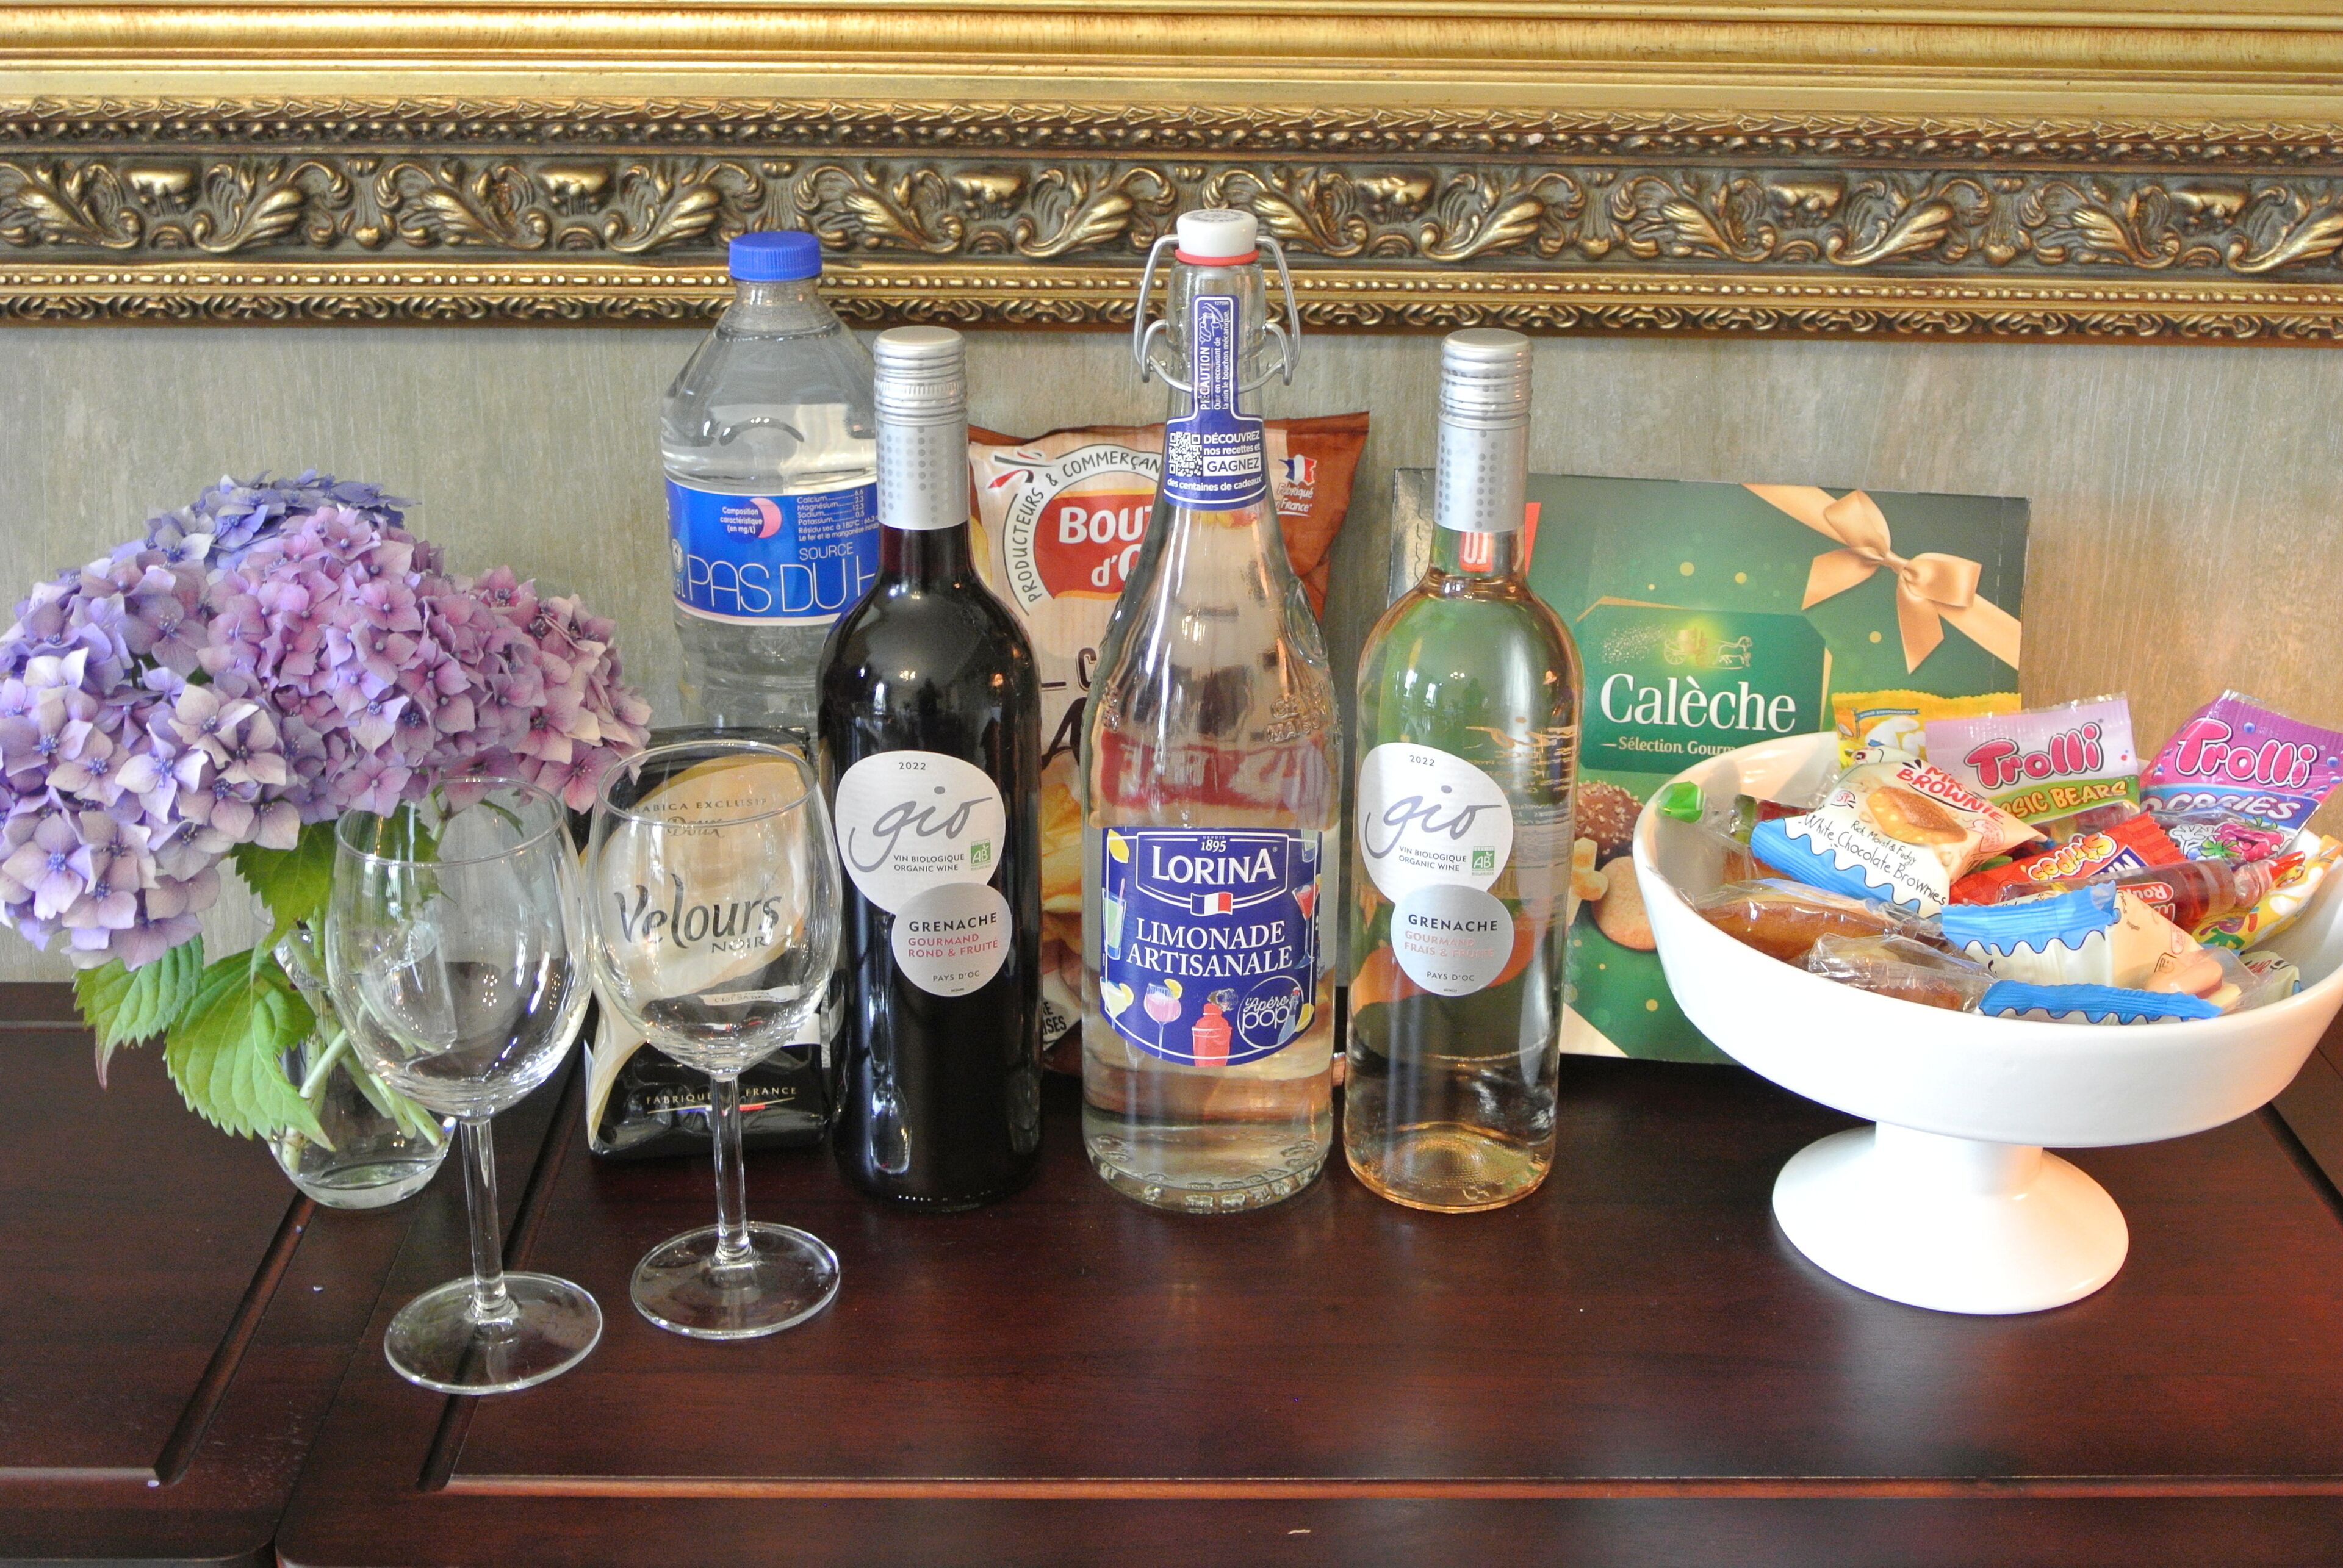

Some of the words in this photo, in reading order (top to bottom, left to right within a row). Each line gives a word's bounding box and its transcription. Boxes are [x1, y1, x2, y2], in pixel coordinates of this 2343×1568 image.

[1214, 337, 1222, 347] de
[1198, 347, 1211, 410] PRÉCAUTION
[1214, 384, 1222, 394] en
[1222, 401, 1229, 410] la
[1203, 430, 1261, 444] DÉCOUVREZ
[1222, 444, 1253, 455] recettes
[1254, 442, 1261, 451] et
[1207, 457, 1259, 472] GAGNEZ
[1167, 478, 1179, 487] des
[1179, 481, 1219, 491] centaines
[1220, 482, 1232, 491] de
[797, 495, 827, 504] Calcium
[797, 502, 838, 512] Magnésium
[722, 506, 758, 516] Composition
[719, 516, 763, 526] caractéristique
[727, 525, 737, 533] (en
[798, 517, 833, 525] Potassium
[1012, 487, 1045, 603] PRODUCTEURS
[1046, 473, 1059, 487] &
[799, 541, 854, 561] SOURCE
[687, 555, 771, 612] PAS
[780, 559, 846, 612] DU
[1600, 673, 1796, 733] Calèche
[1618, 736, 1685, 755] Sélection
[2175, 717, 2317, 789] Trolli
[1409, 754, 1435, 767] 2022
[1964, 722, 2104, 789] Trolli
[899, 761, 926, 771] 2022
[1896, 768, 2004, 824] BROWNIE
[2048, 780, 2128, 809] BEARS
[696, 798, 767, 809] EXCLUSIF
[848, 786, 993, 873] gio
[1365, 785, 1502, 859] gio
[1201, 839, 1226, 852] 1895
[1868, 831, 1890, 849] Moist
[1896, 845, 1917, 866] Fudgy
[911, 854, 965, 863] BIOLOGIQUE
[972, 849, 988, 863] AB
[1399, 846, 1412, 854] VIN
[1415, 849, 1467, 863] BIOLOGIQUE
[1474, 855, 1491, 868] AB
[1804, 812, 1834, 841] White
[1838, 831, 1891, 874] Chocolate
[1893, 862, 1946, 905] Brownies
[2028, 832, 2118, 881] Stripes
[894, 864, 934, 872] ORGANIC
[1151, 845, 1277, 885] LORINA
[1399, 855, 1435, 869] ORGANIC
[1438, 863, 1459, 872] WINE
[614, 872, 782, 949] Velours
[909, 912, 997, 932] GRENACHE
[1408, 915, 1497, 932] GRENACHE
[908, 933, 979, 946] GOURMAND
[1136, 917, 1286, 951] LIMONADE
[1405, 930, 1475, 947] GOURMAND
[711, 935, 771, 953] NOIR
[909, 949, 943, 958] ROND
[948, 948, 956, 957] &
[960, 937, 998, 955] FRUITÉ
[1405, 941, 1435, 955] FRAIS
[1126, 943, 1293, 977] ARTISANALE
[958, 970, 980, 980] D'OC
[1427, 971, 1448, 980] PAYS
[1242, 1005, 1289, 1034] pop
[746, 1087, 797, 1097] FRANCE
